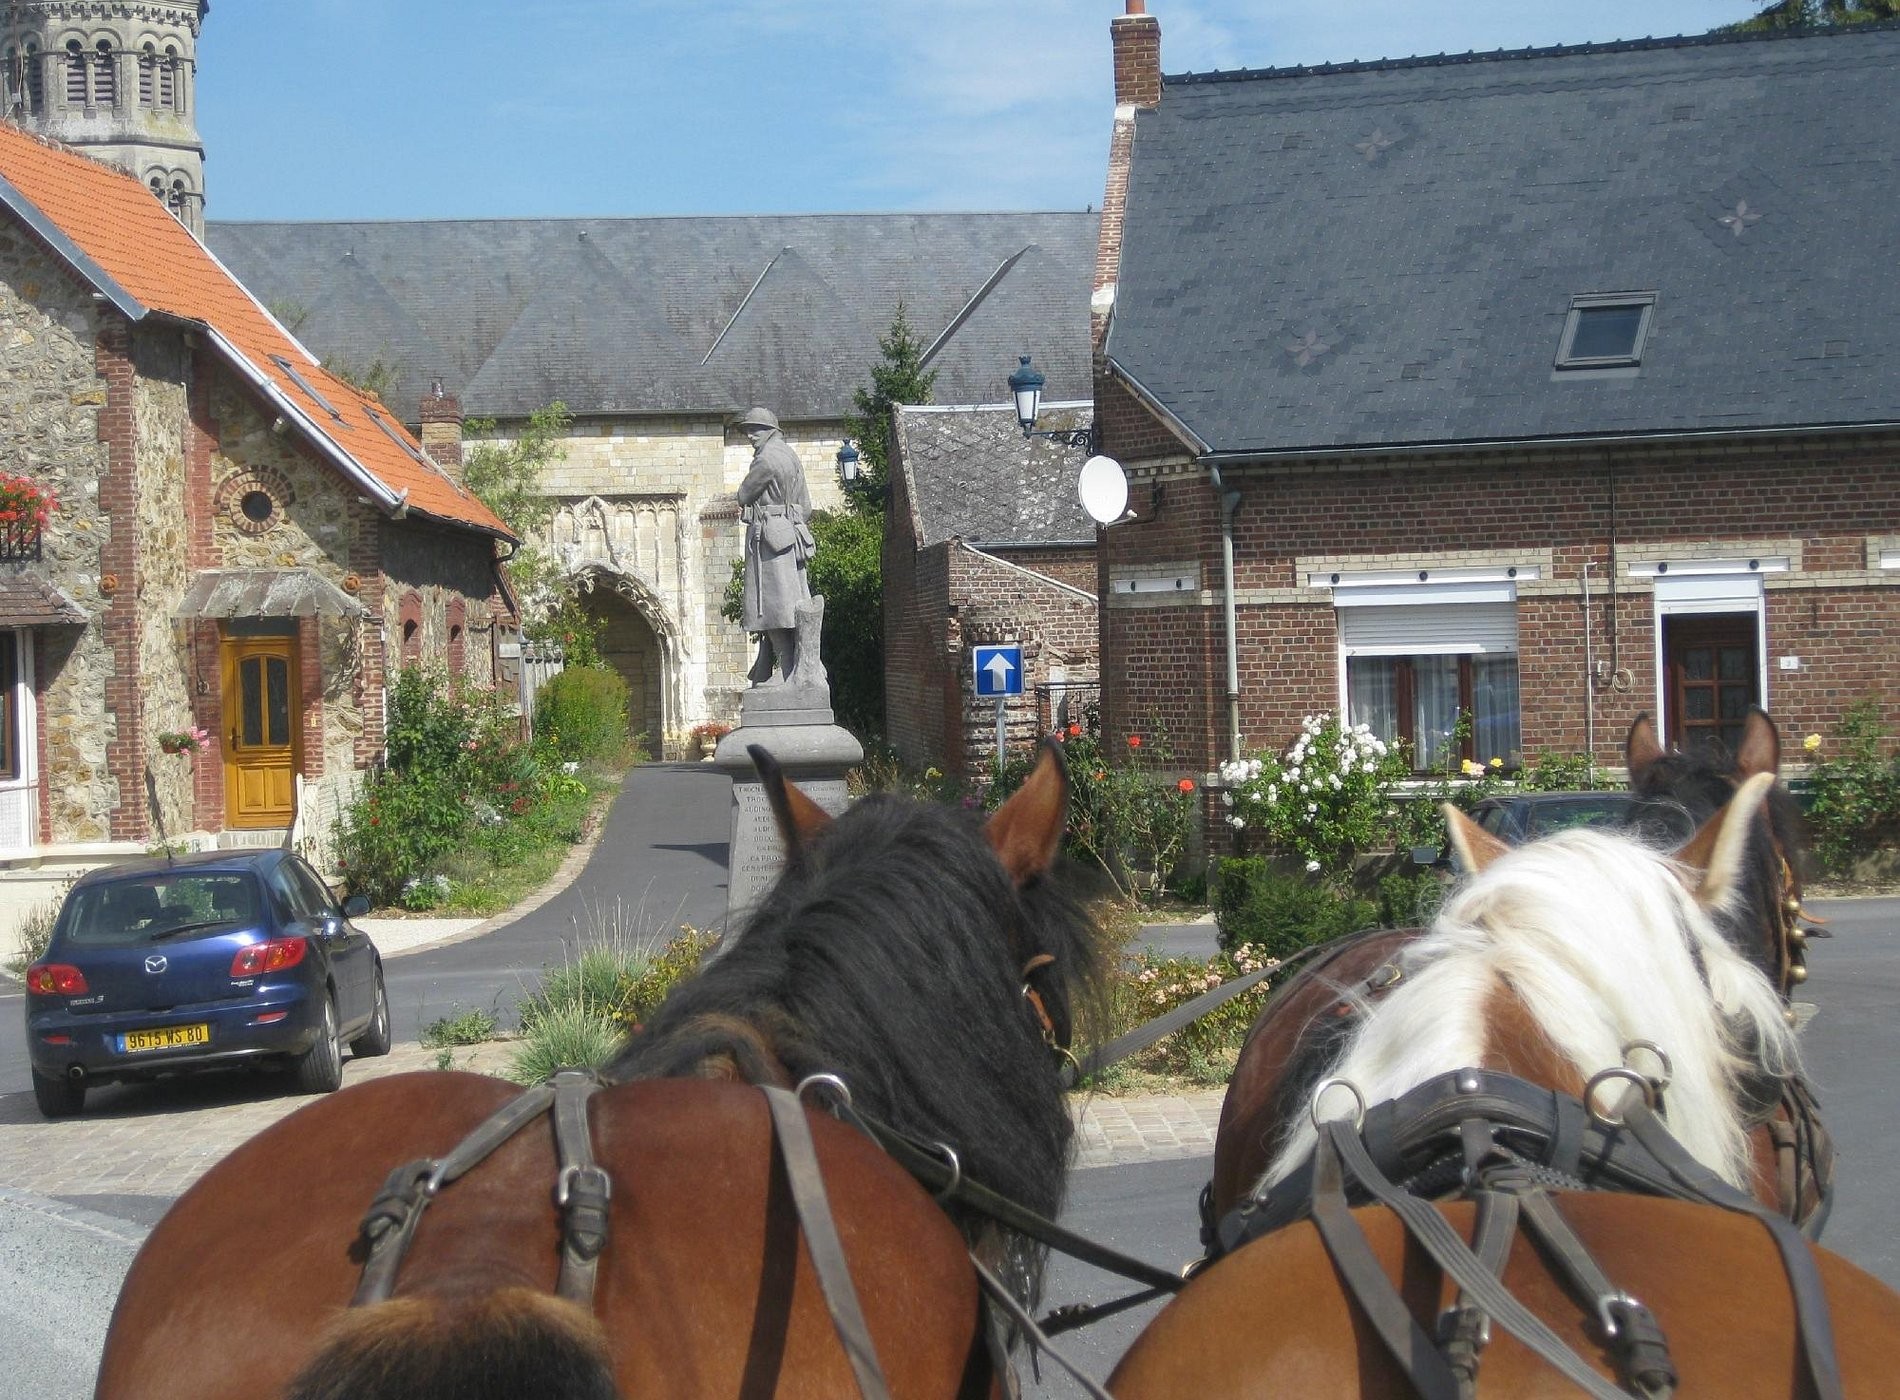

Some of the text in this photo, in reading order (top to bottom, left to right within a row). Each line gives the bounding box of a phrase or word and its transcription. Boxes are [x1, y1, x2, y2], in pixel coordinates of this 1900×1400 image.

[129, 1031, 161, 1048] 9615
[166, 1029, 182, 1044] WS
[187, 1026, 203, 1042] 80
